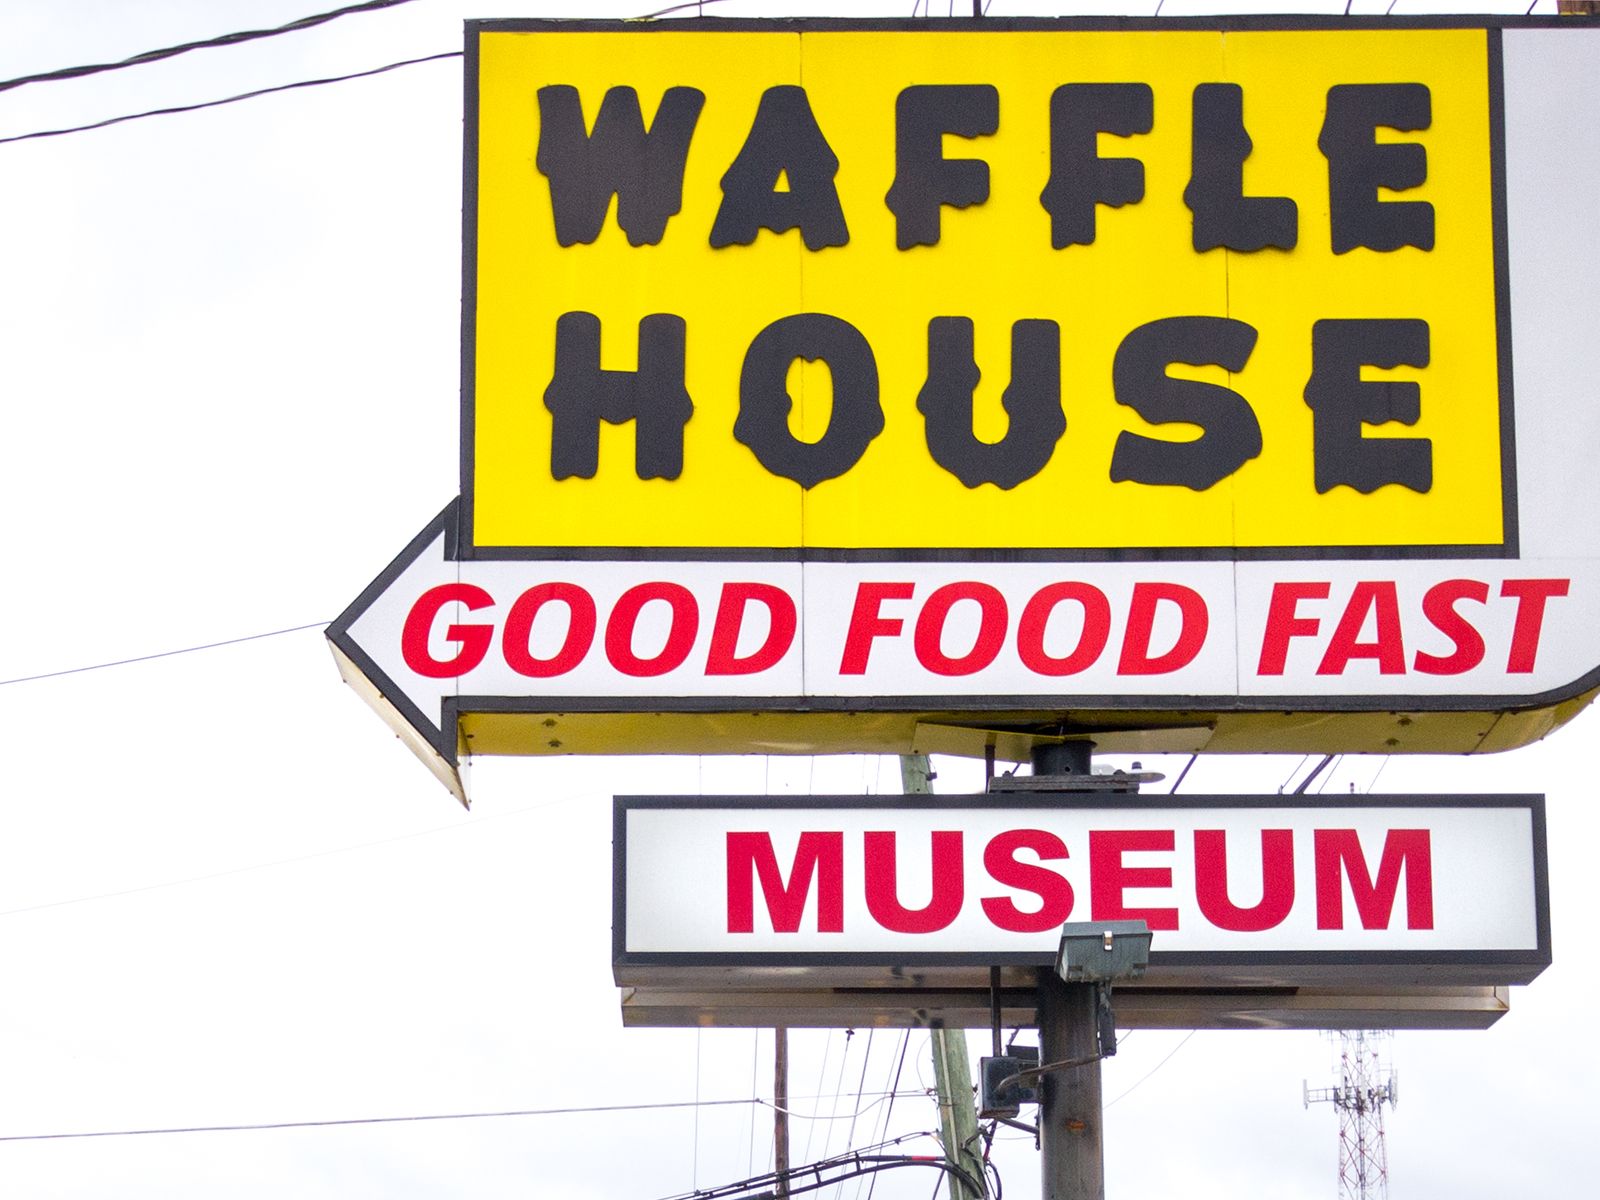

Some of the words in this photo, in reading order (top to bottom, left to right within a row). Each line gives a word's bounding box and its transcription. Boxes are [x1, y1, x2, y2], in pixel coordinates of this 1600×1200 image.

[536, 83, 1435, 255] WAFFLE
[543, 311, 1432, 494] HOUSE
[401, 582, 797, 678] GOOD
[840, 581, 1208, 677] FOOD
[1258, 579, 1570, 676] FAST
[726, 828, 1434, 934] MUSEUM
